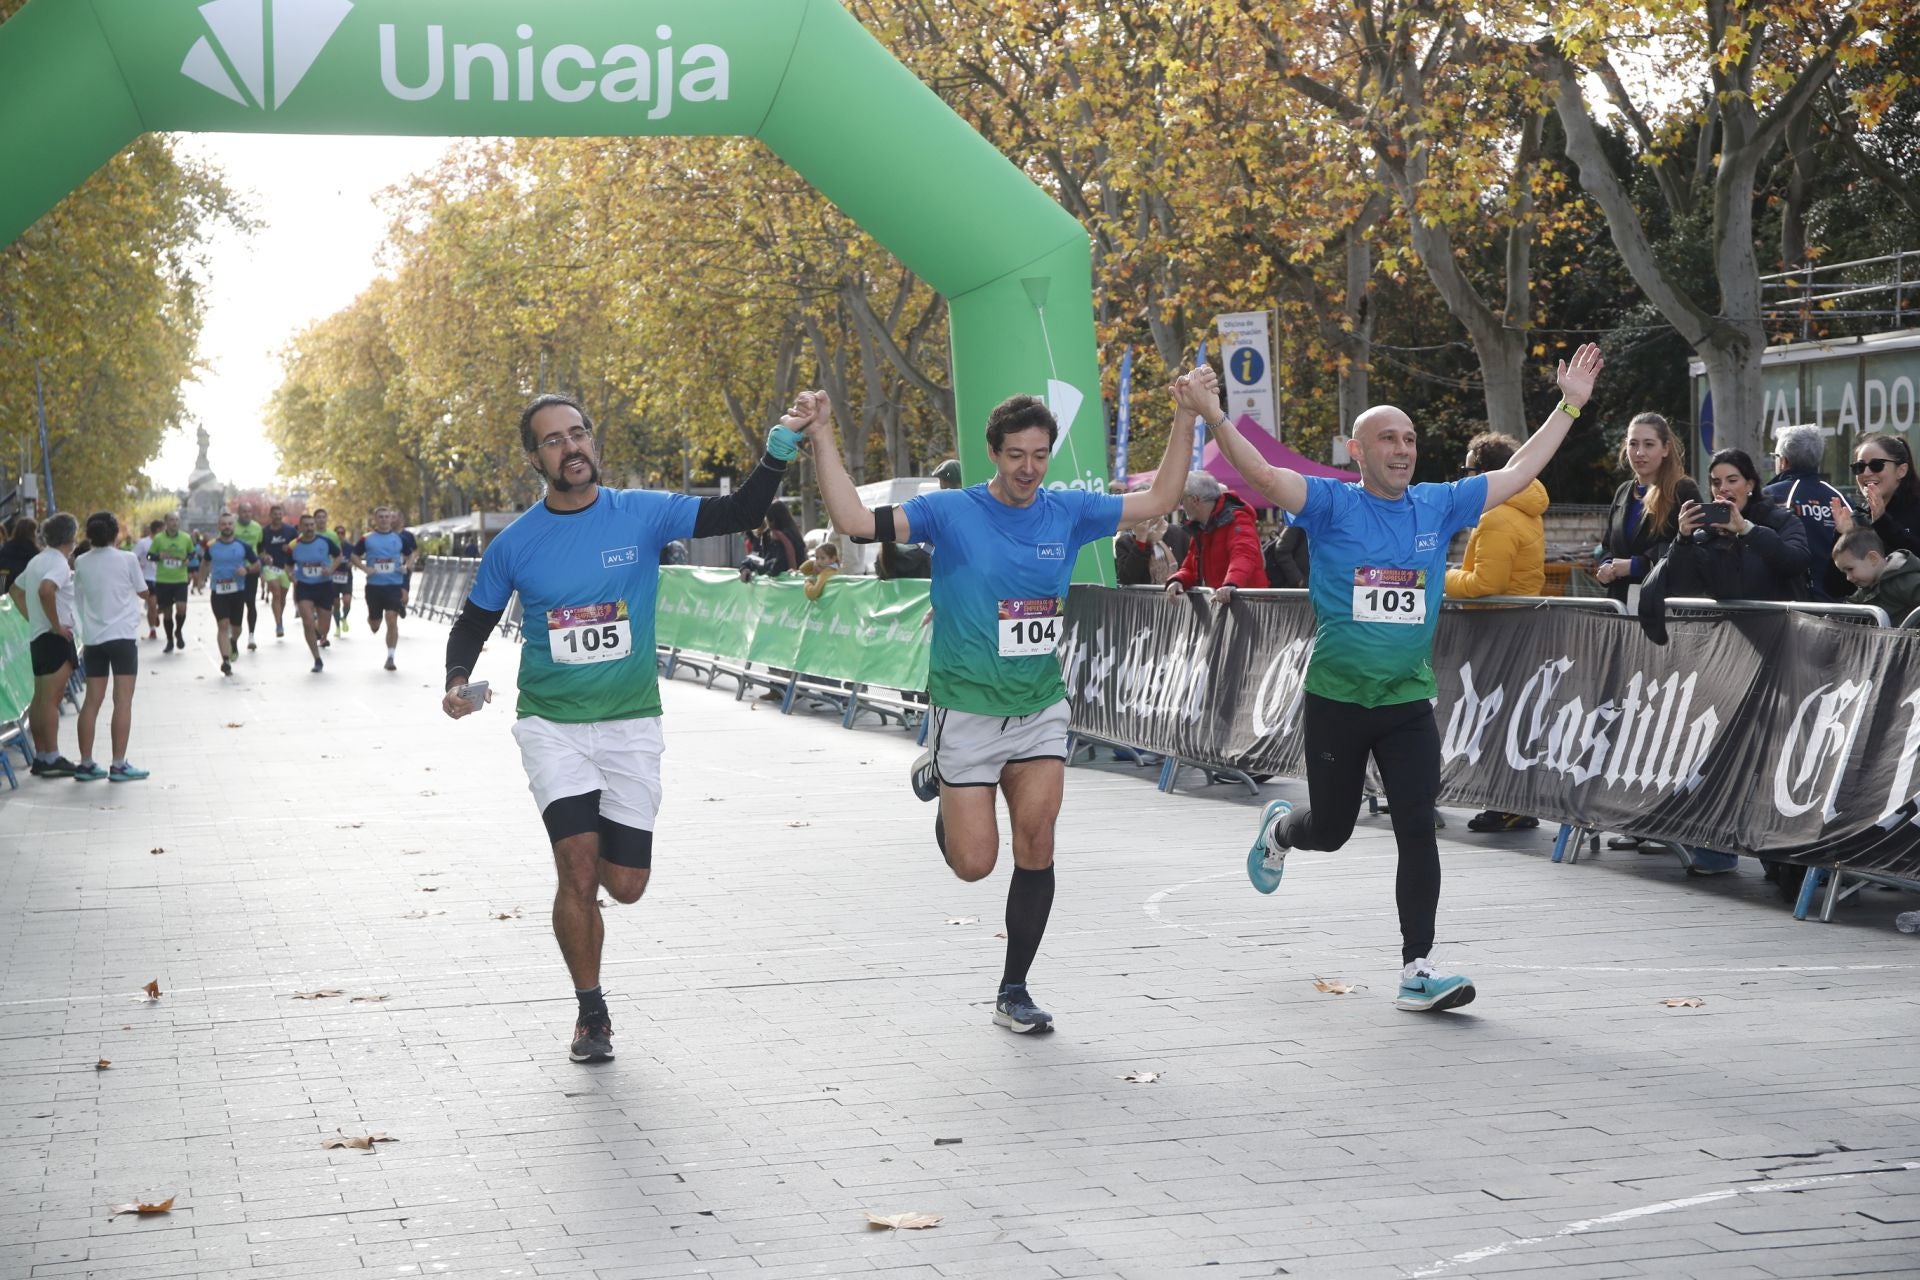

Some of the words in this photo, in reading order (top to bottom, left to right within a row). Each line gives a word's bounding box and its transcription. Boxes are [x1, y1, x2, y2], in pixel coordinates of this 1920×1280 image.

[379, 24, 730, 120] Unicaja
[607, 554, 624, 563] AVL
[1365, 589, 1415, 613] 103
[563, 625, 620, 653] 105
[1011, 619, 1056, 645] 104
[1440, 661, 1504, 766] de
[1505, 655, 1720, 794] Castilla
